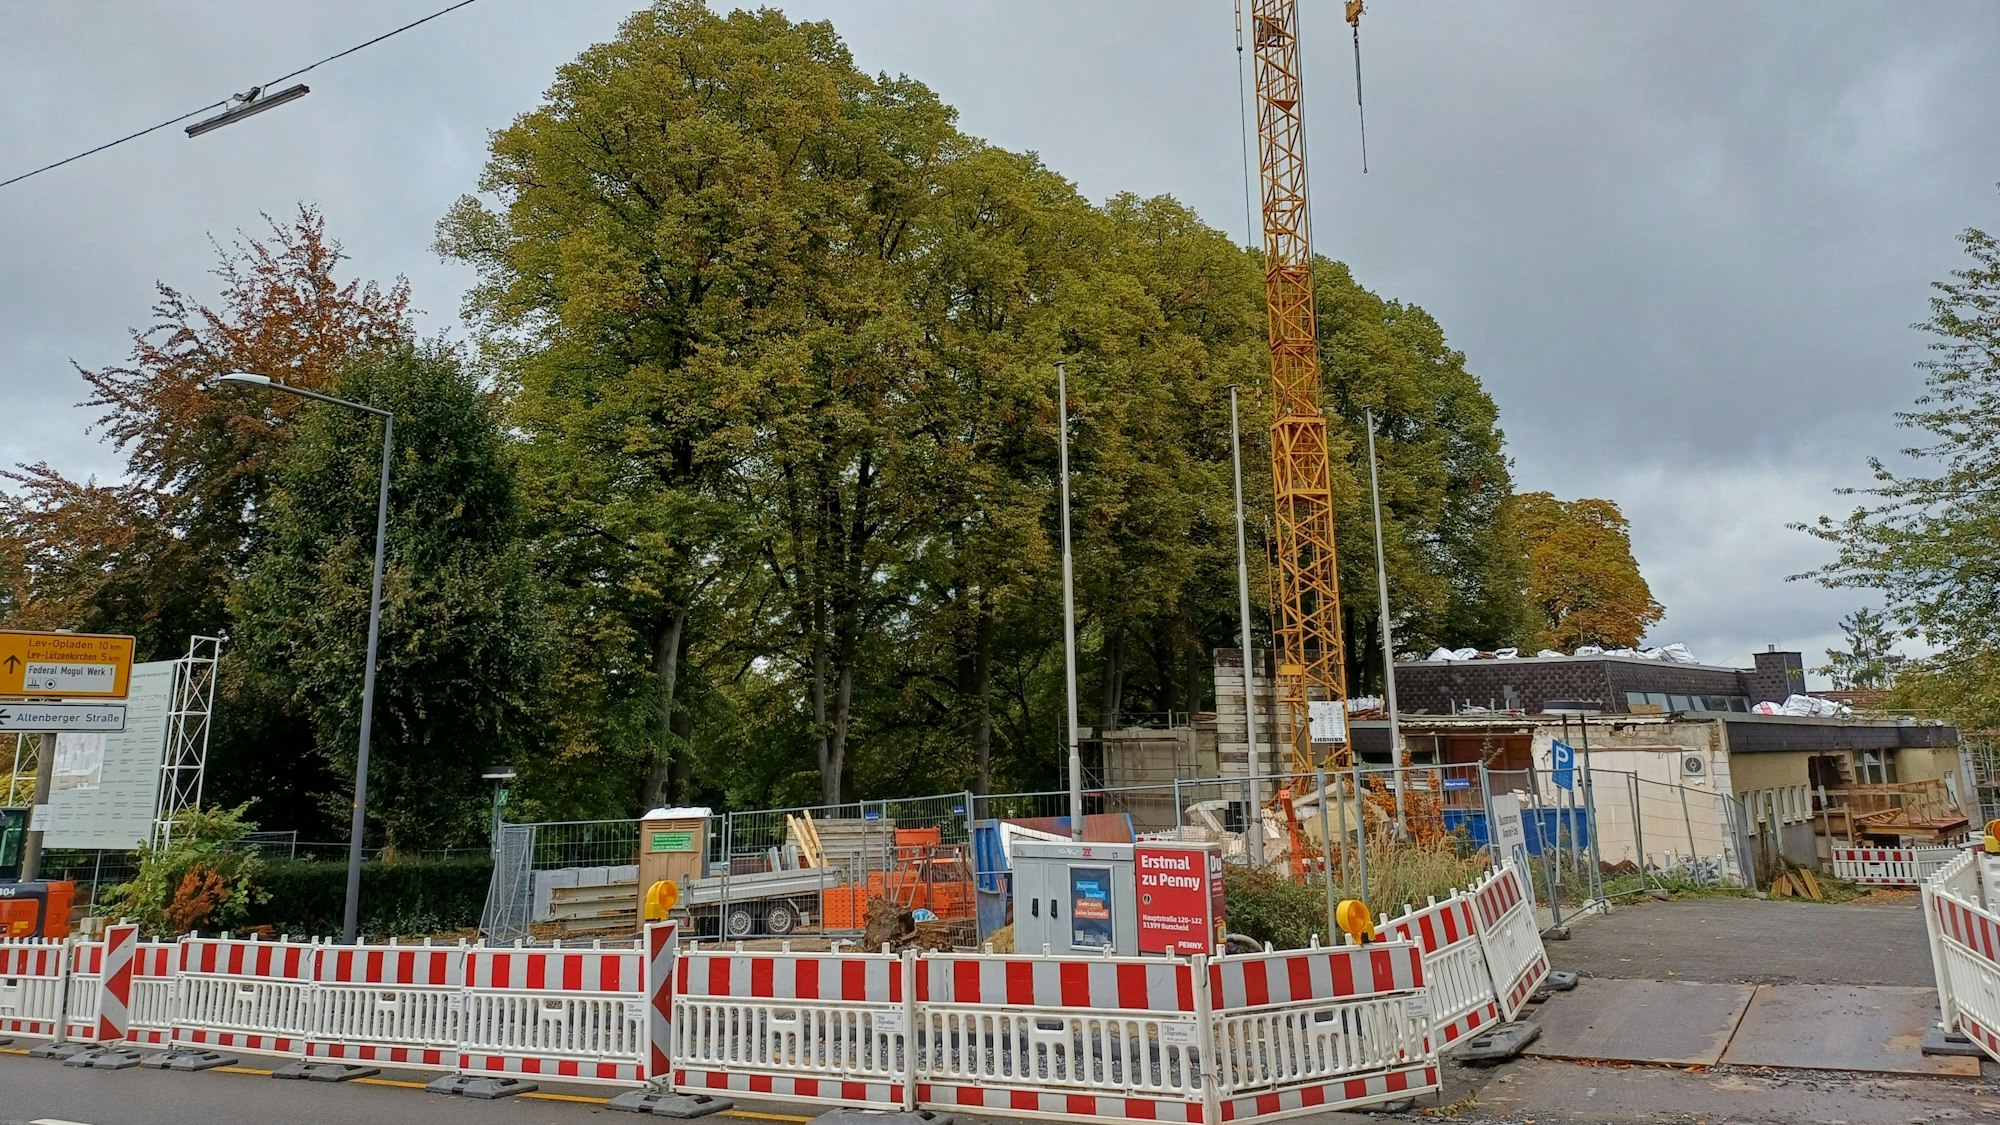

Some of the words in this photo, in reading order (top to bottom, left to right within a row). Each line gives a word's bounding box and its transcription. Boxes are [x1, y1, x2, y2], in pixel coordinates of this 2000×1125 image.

[29, 638, 93, 650] Lev-Opladen
[99, 641, 109, 650] 10
[27, 650, 97, 661] Lev-Lützenkirchen
[101, 652, 107, 661] 5
[28, 665, 58, 675] Federal
[60, 666, 84, 677] Mogul
[87, 667, 106, 676] Werk
[109, 668, 113, 676] 1
[16, 713, 81, 724] Altenberger
[85, 713, 120, 723] Straße
[1555, 745, 1569, 771] P
[1141, 855, 1190, 870] Erstmal
[1210, 855, 1222, 873] Du
[1142, 874, 1157, 886] zu
[1159, 873, 1201, 891] Penny
[1142, 914, 1177, 923] Hauptstraße
[1161, 922, 1190, 931] Burscheid
